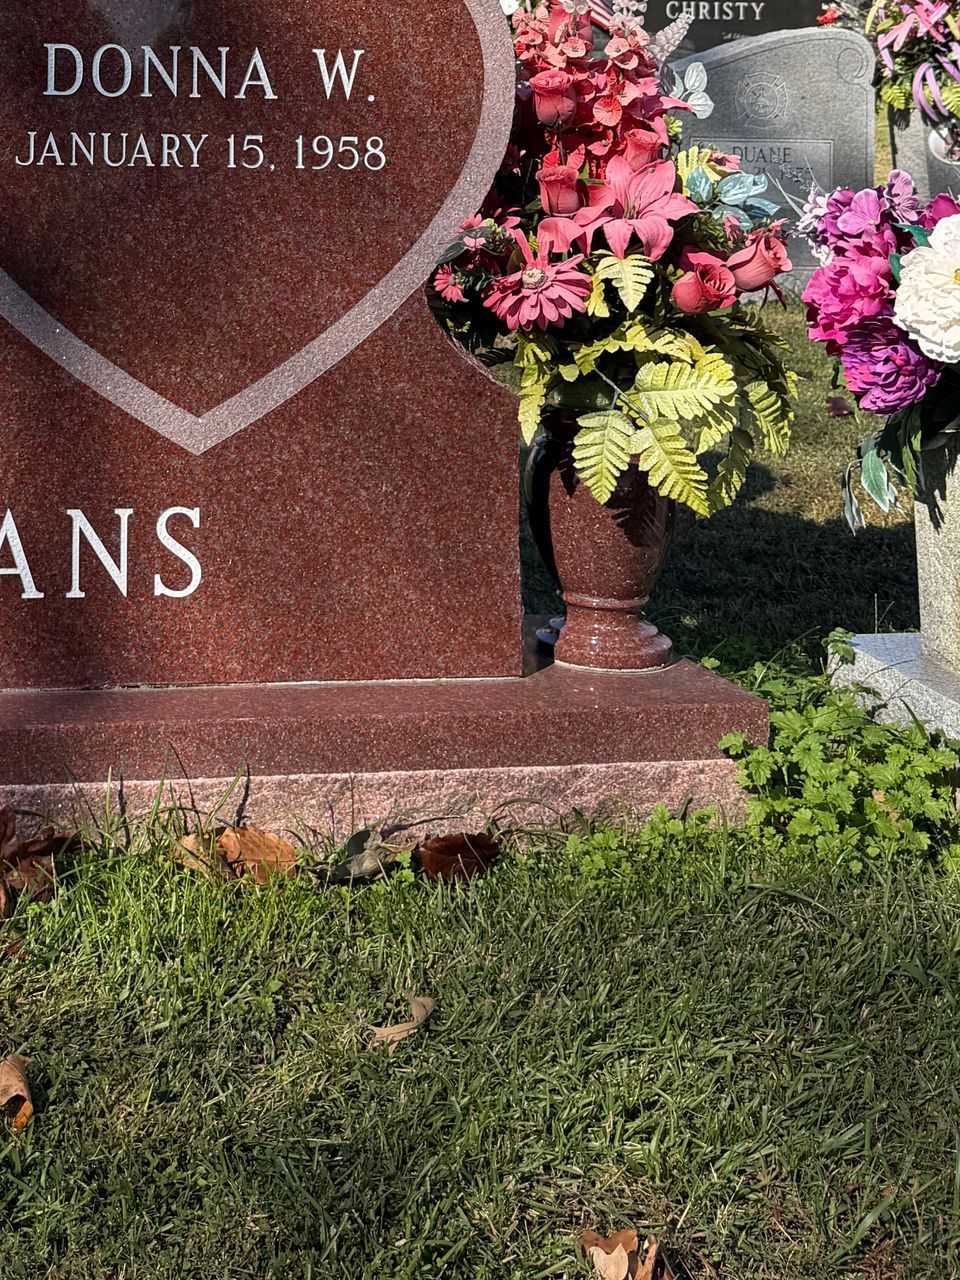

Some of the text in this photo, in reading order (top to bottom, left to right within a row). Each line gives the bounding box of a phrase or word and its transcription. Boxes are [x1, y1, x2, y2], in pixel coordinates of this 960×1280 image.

[665, 0, 765, 20] CHRISTY
[43, 43, 375, 102] DONNA W.
[15, 131, 387, 171] JANUARY 15, 1958
[732, 146, 792, 164] DUANE
